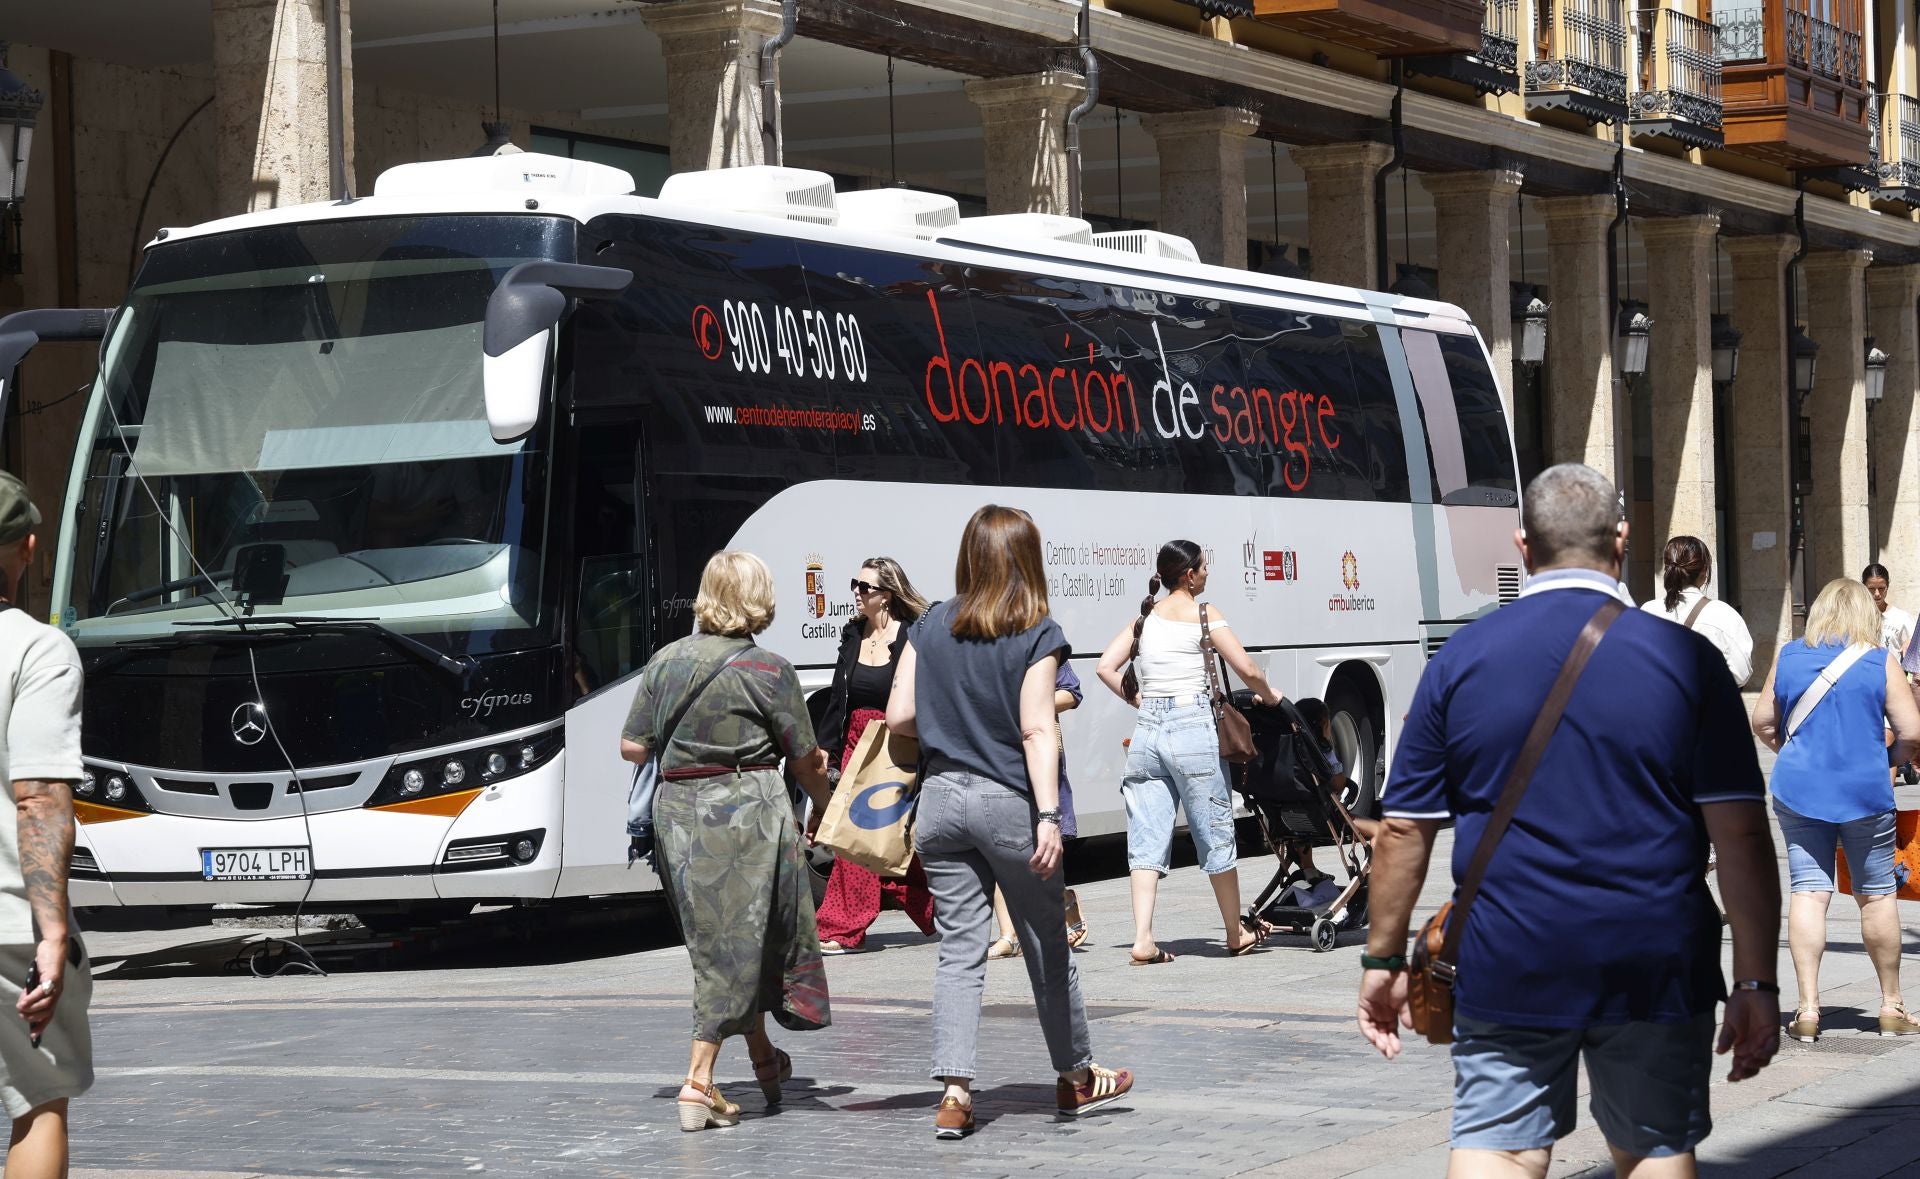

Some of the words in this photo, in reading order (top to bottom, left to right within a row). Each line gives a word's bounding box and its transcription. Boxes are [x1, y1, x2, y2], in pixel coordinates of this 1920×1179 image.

[723, 299, 770, 374] 900
[775, 304, 804, 378] 40
[802, 309, 835, 380] 50
[836, 312, 867, 382] 60
[924, 288, 1140, 433] donación
[1152, 320, 1205, 440] de
[1211, 383, 1340, 492] sangre
[704, 404, 876, 435] www.centrodehemoterapiacyl.es
[1046, 541, 1076, 566] Centro
[1079, 542, 1090, 566] de
[1092, 542, 1147, 571] Hemoterapia
[1048, 573, 1059, 597] de
[1061, 573, 1095, 597] Castilla
[1096, 579, 1102, 602] y
[1103, 573, 1126, 597] León
[828, 601, 855, 616] Junta
[1328, 594, 1375, 611] ambuiberica
[801, 623, 837, 639] Castilla
[461, 689, 533, 717] cygnus
[215, 852, 262, 873] 9704
[268, 851, 305, 872] LPH
